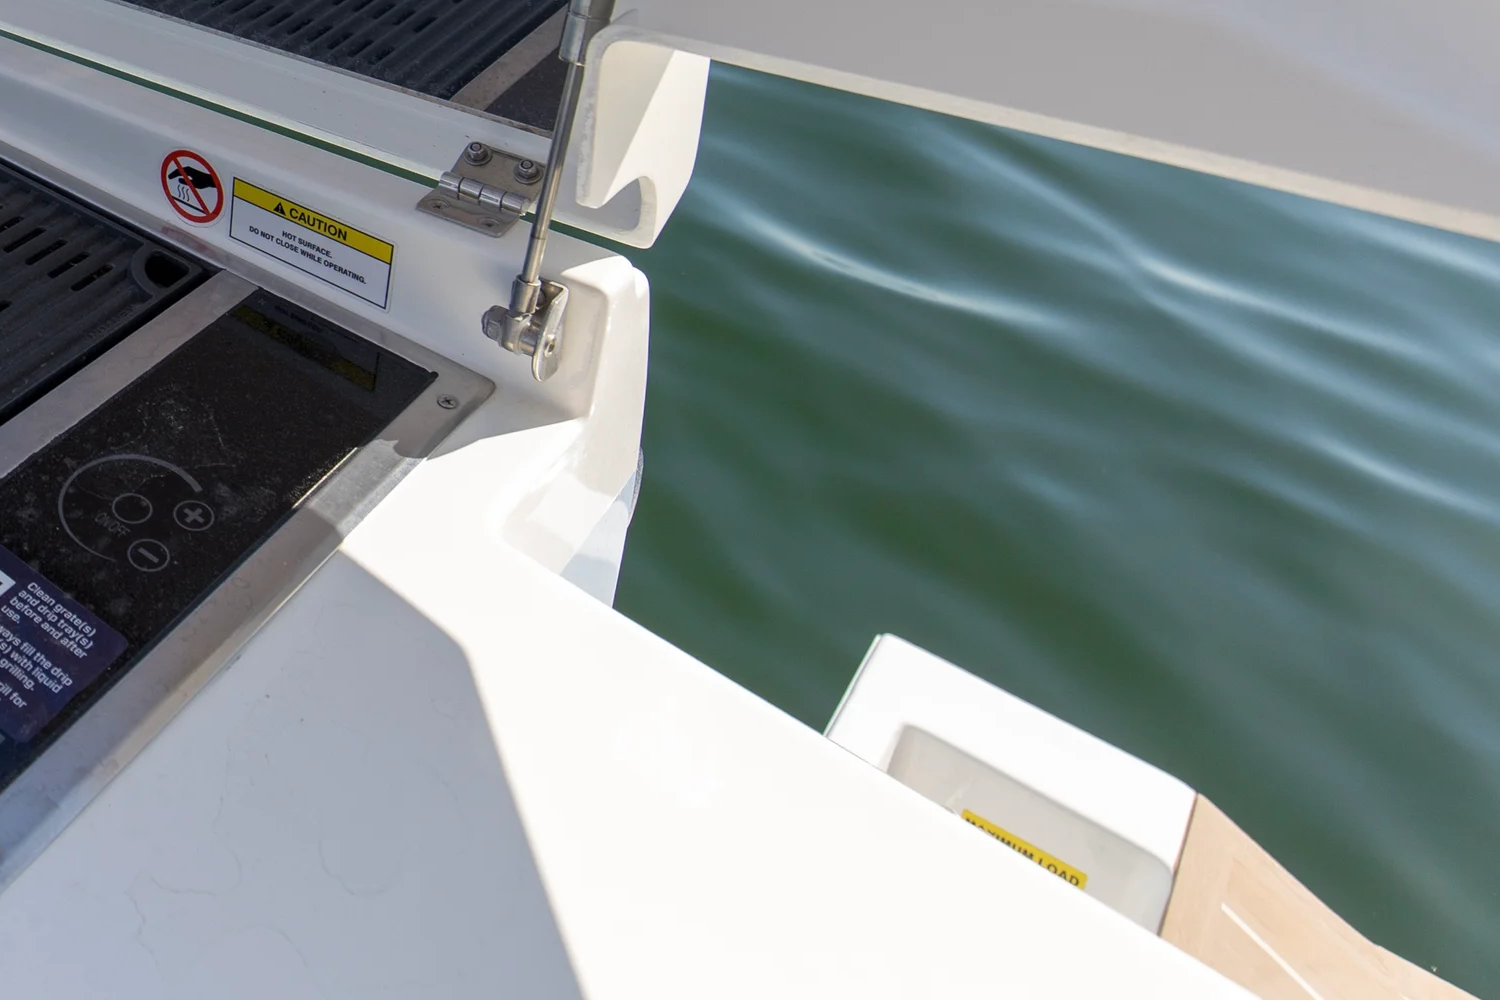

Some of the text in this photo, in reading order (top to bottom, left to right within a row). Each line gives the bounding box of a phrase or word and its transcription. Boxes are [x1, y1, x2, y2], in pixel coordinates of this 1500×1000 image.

[282, 231, 332, 258] HOT SURFACE.
[290, 208, 347, 240] CAUTION
[249, 226, 366, 284] DO NOT CLOSE WHILE OPERATING.
[1, 605, 20, 624] use.
[9, 596, 87, 659] before and after
[19, 590, 93, 649] and drip tray(s)
[27, 582, 96, 637] Clean grate(s)
[10, 651, 33, 671] with
[32, 667, 63, 693] liquid
[20, 642, 36, 656] fill
[33, 653, 52, 670] the
[51, 667, 73, 686] drip
[9, 692, 27, 708] for
